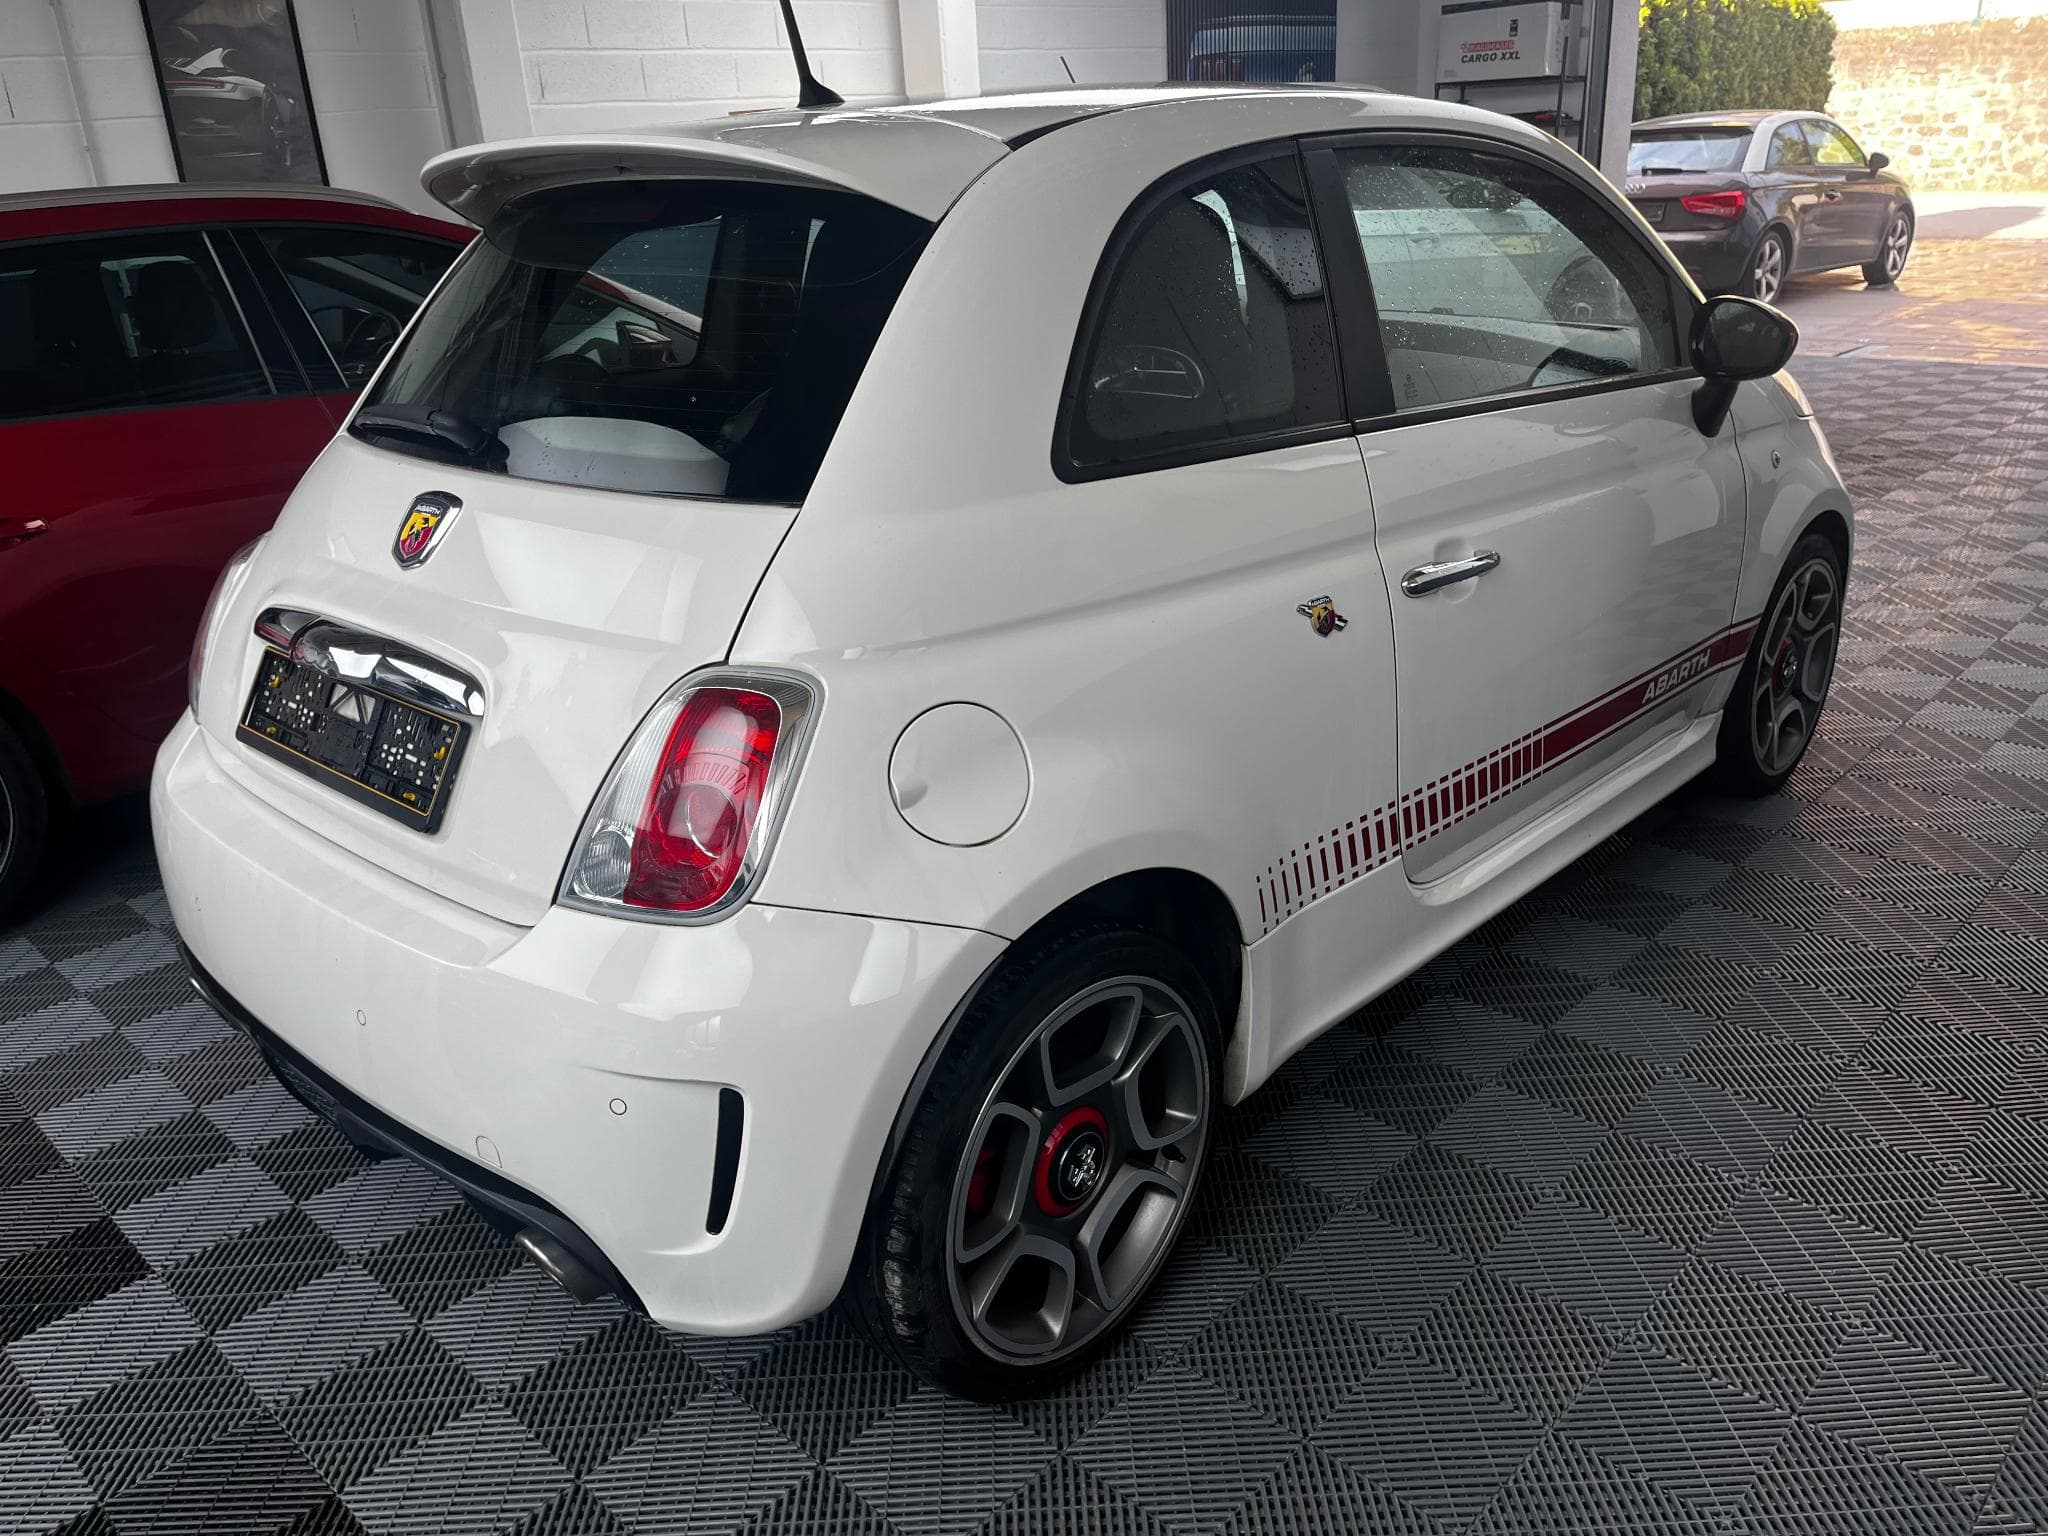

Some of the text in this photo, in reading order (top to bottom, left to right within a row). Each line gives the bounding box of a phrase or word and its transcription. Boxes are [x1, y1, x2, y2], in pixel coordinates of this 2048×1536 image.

[1461, 51, 1521, 64] CARGO XXL
[414, 505, 441, 514] ABARTH
[1641, 647, 1711, 704] ABARTH
